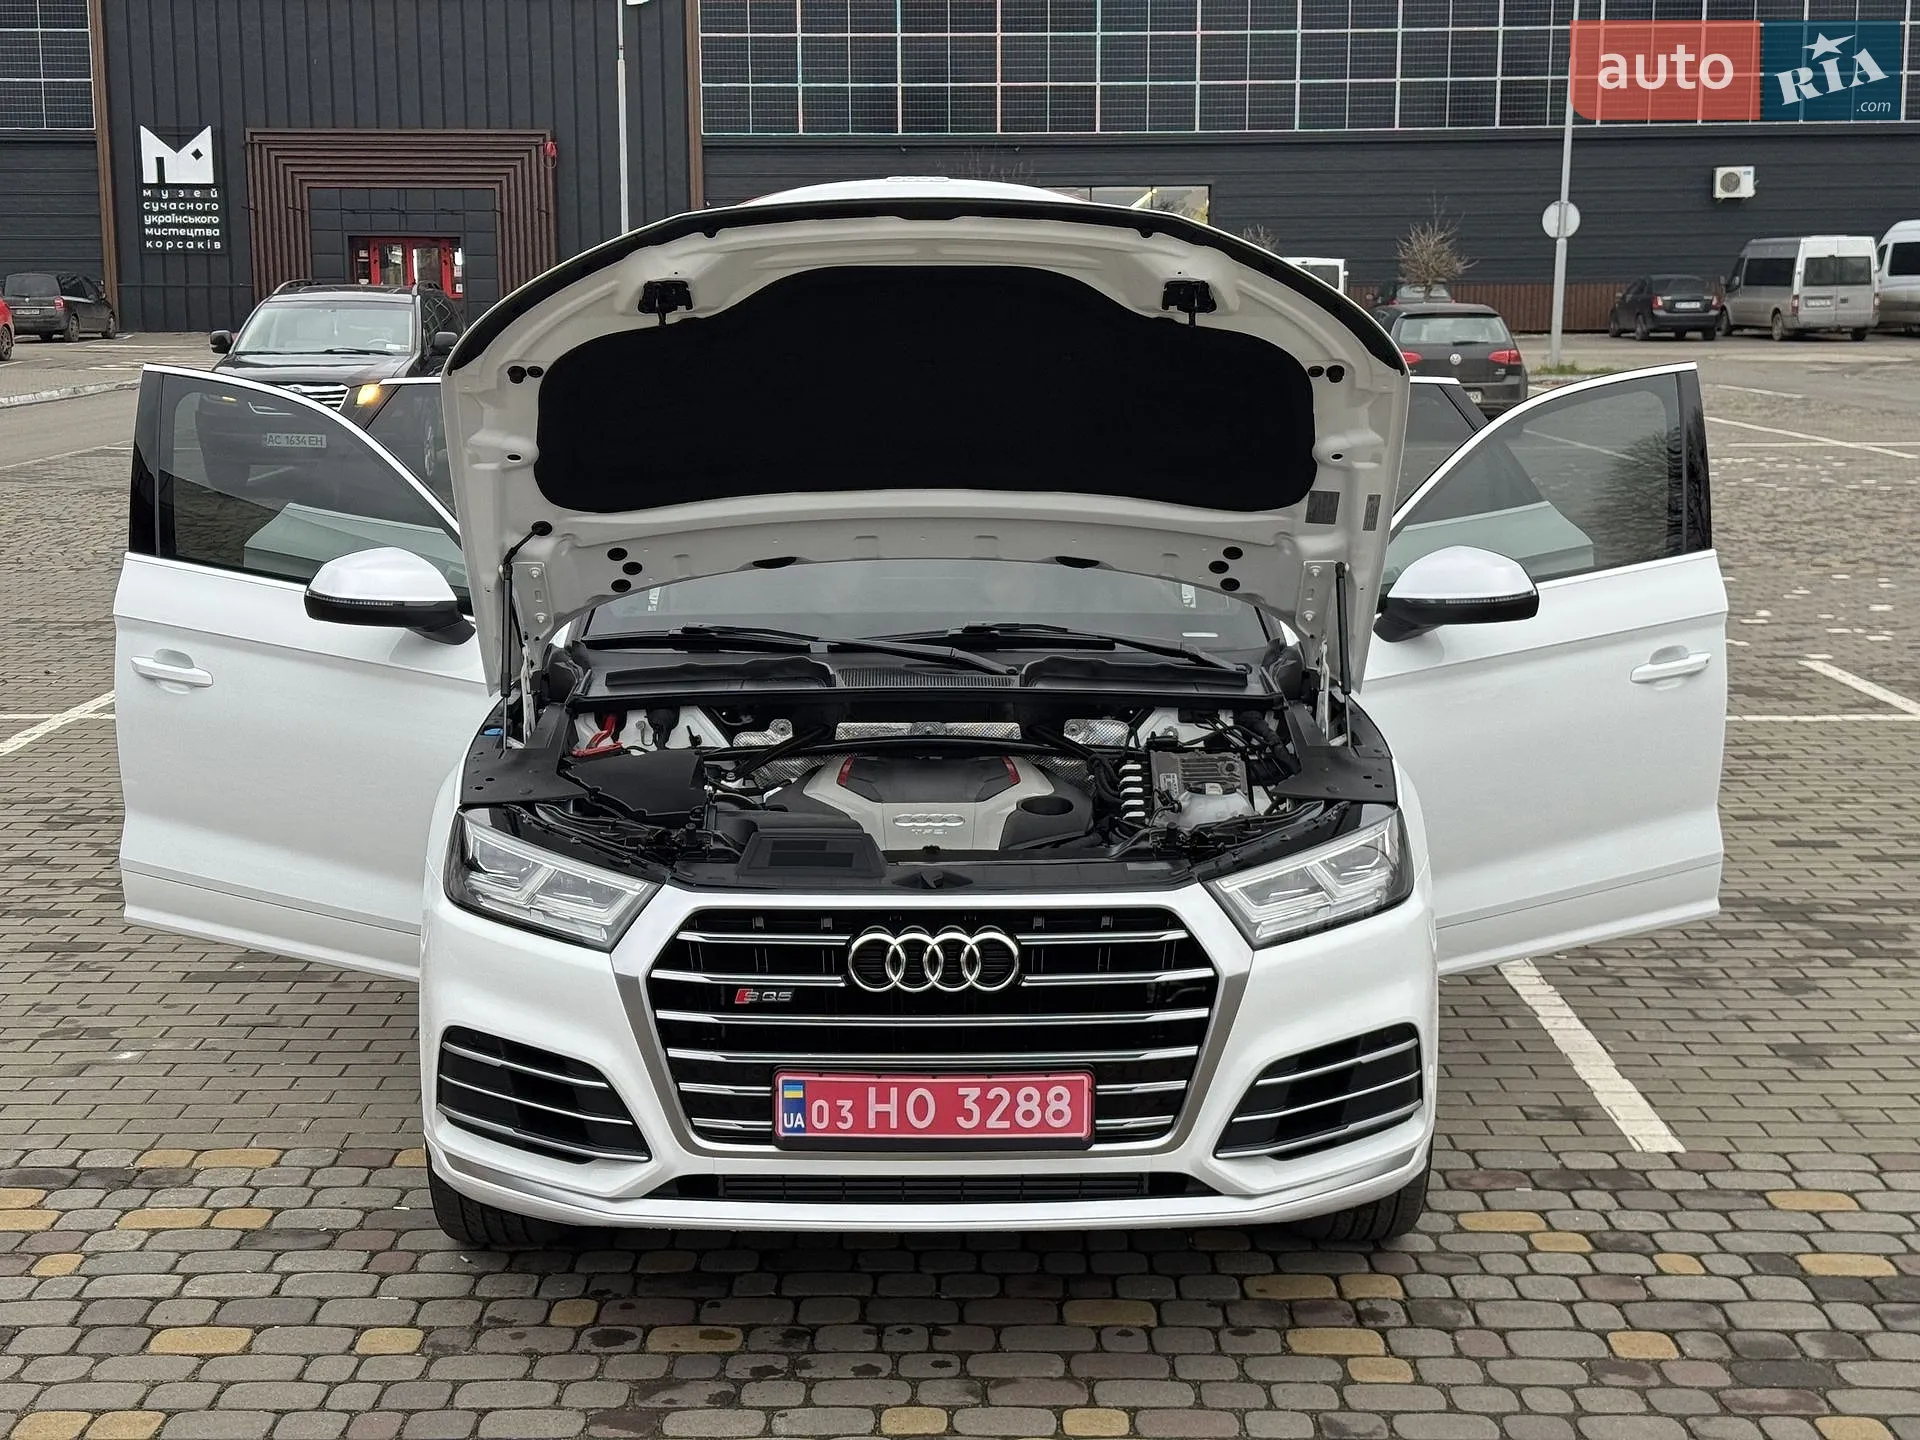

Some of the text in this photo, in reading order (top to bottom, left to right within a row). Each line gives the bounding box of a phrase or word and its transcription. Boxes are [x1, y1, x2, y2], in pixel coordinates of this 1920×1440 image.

[142, 188, 218, 200] музей
[143, 201, 219, 212] сучасного
[144, 213, 220, 225] українського
[145, 227, 220, 237] мистецтва
[146, 239, 221, 251] корсаків
[783, 1085, 1072, 1130] UA 03 HO 3288
